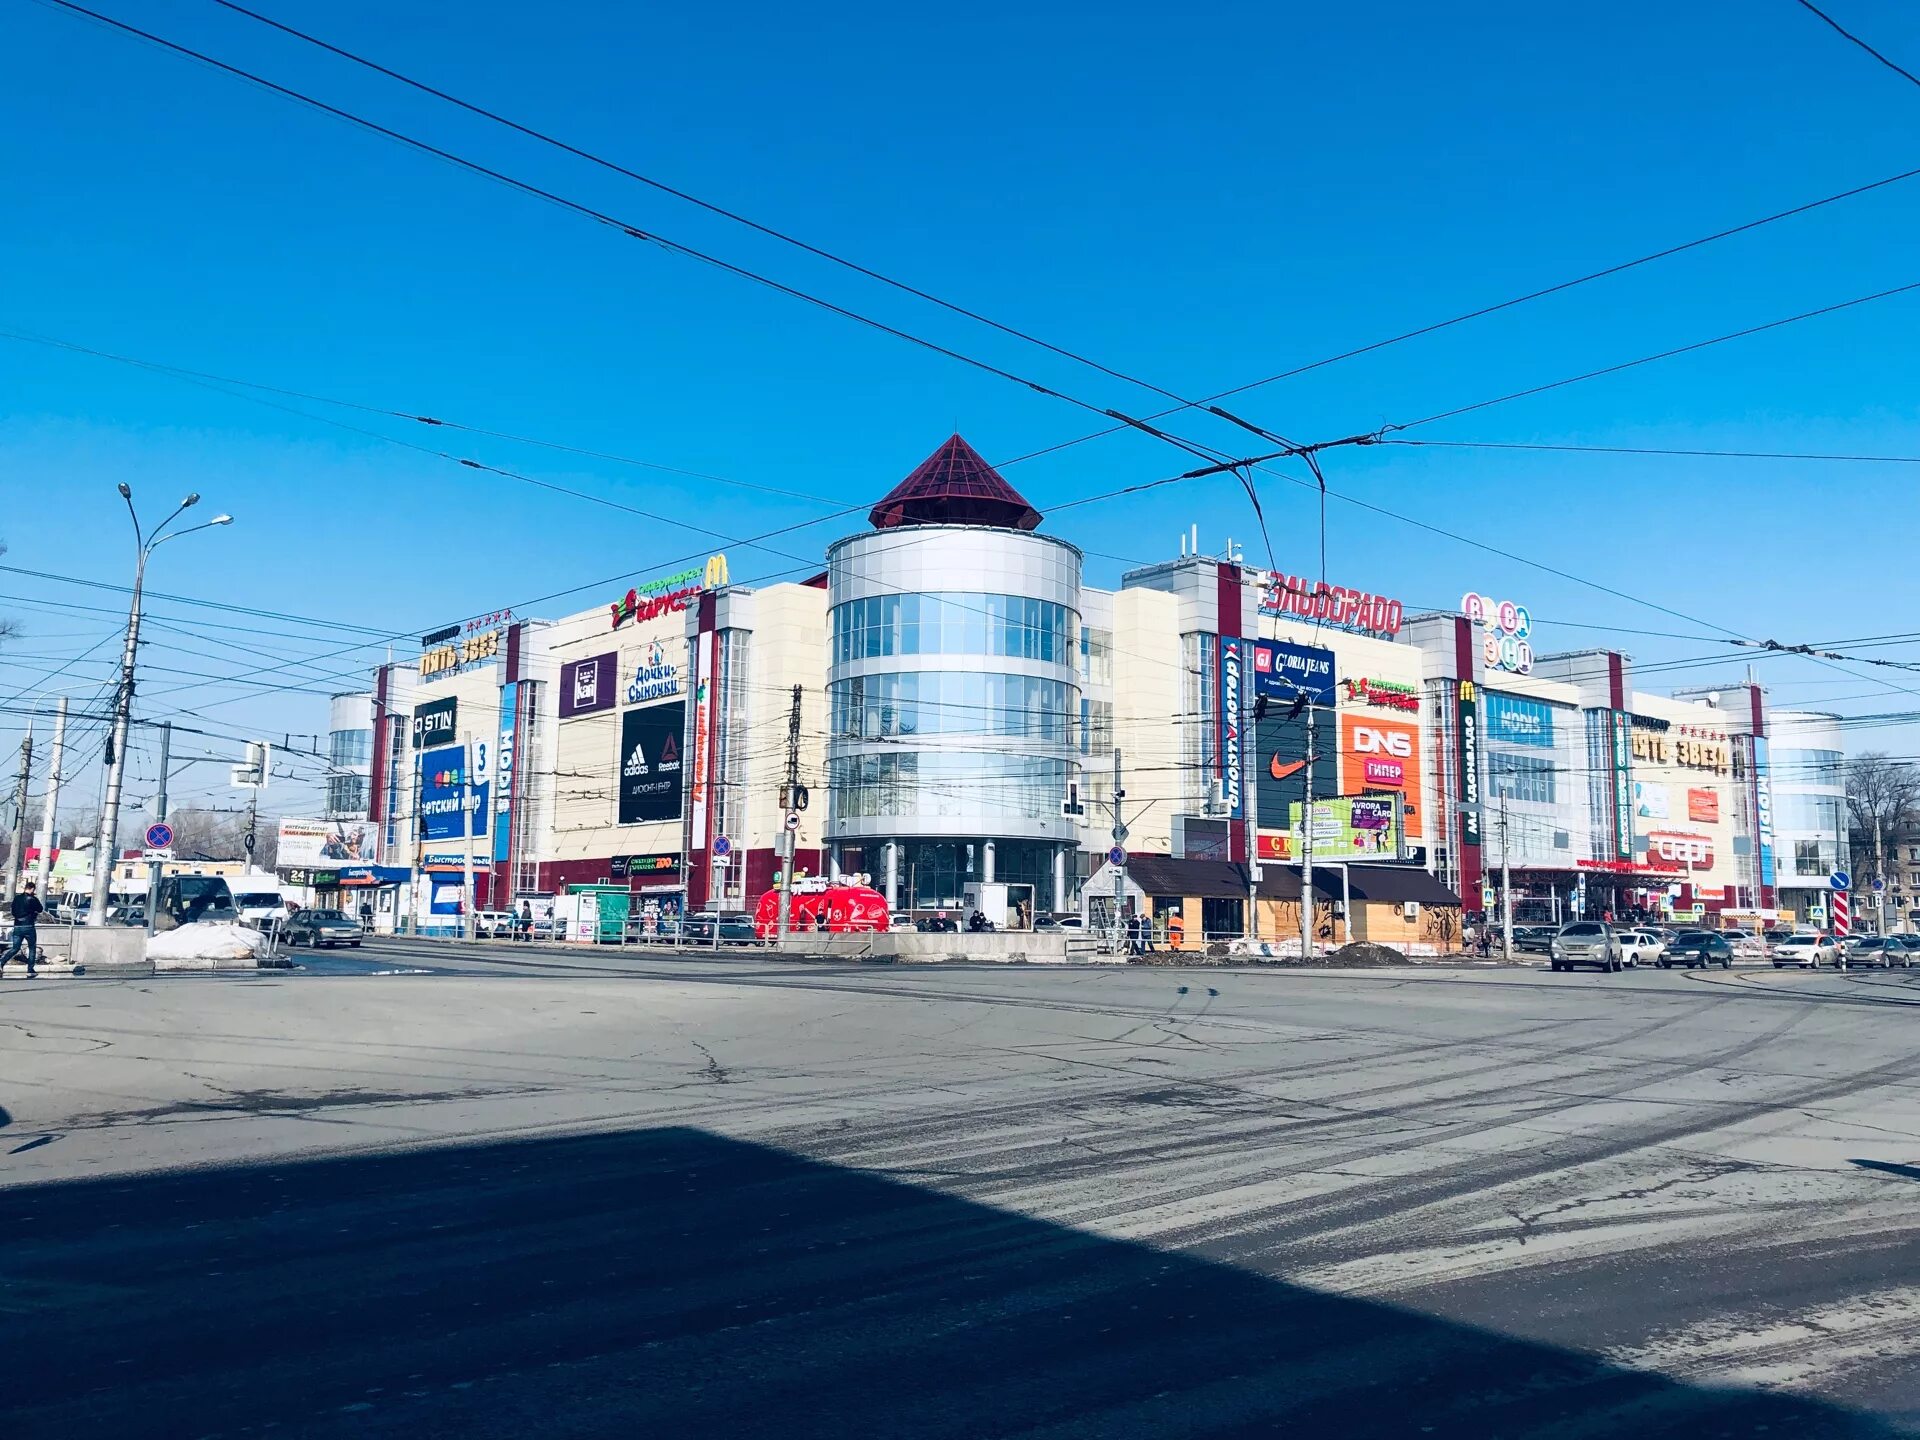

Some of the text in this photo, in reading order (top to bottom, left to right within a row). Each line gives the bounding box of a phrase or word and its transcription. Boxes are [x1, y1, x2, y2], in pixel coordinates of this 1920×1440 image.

[419, 631, 499, 676] ПЯТЬ ЗВЕЗ
[1256, 654, 1270, 668] GJ
[1275, 653, 1330, 678] GLORIA JEANS
[628, 679, 679, 703] Сыночки
[1501, 713, 1541, 734] MODIS
[1353, 726, 1412, 758] DNS
[477, 743, 486, 772] 3
[623, 765, 649, 777] adidas
[658, 761, 680, 772] Reebok
[1367, 763, 1402, 779] ГИПЕР
[1351, 801, 1382, 811] AVRORA
[1372, 810, 1392, 818] CARD
[428, 855, 491, 865] Быстроньги
[290, 869, 305, 879] 24
